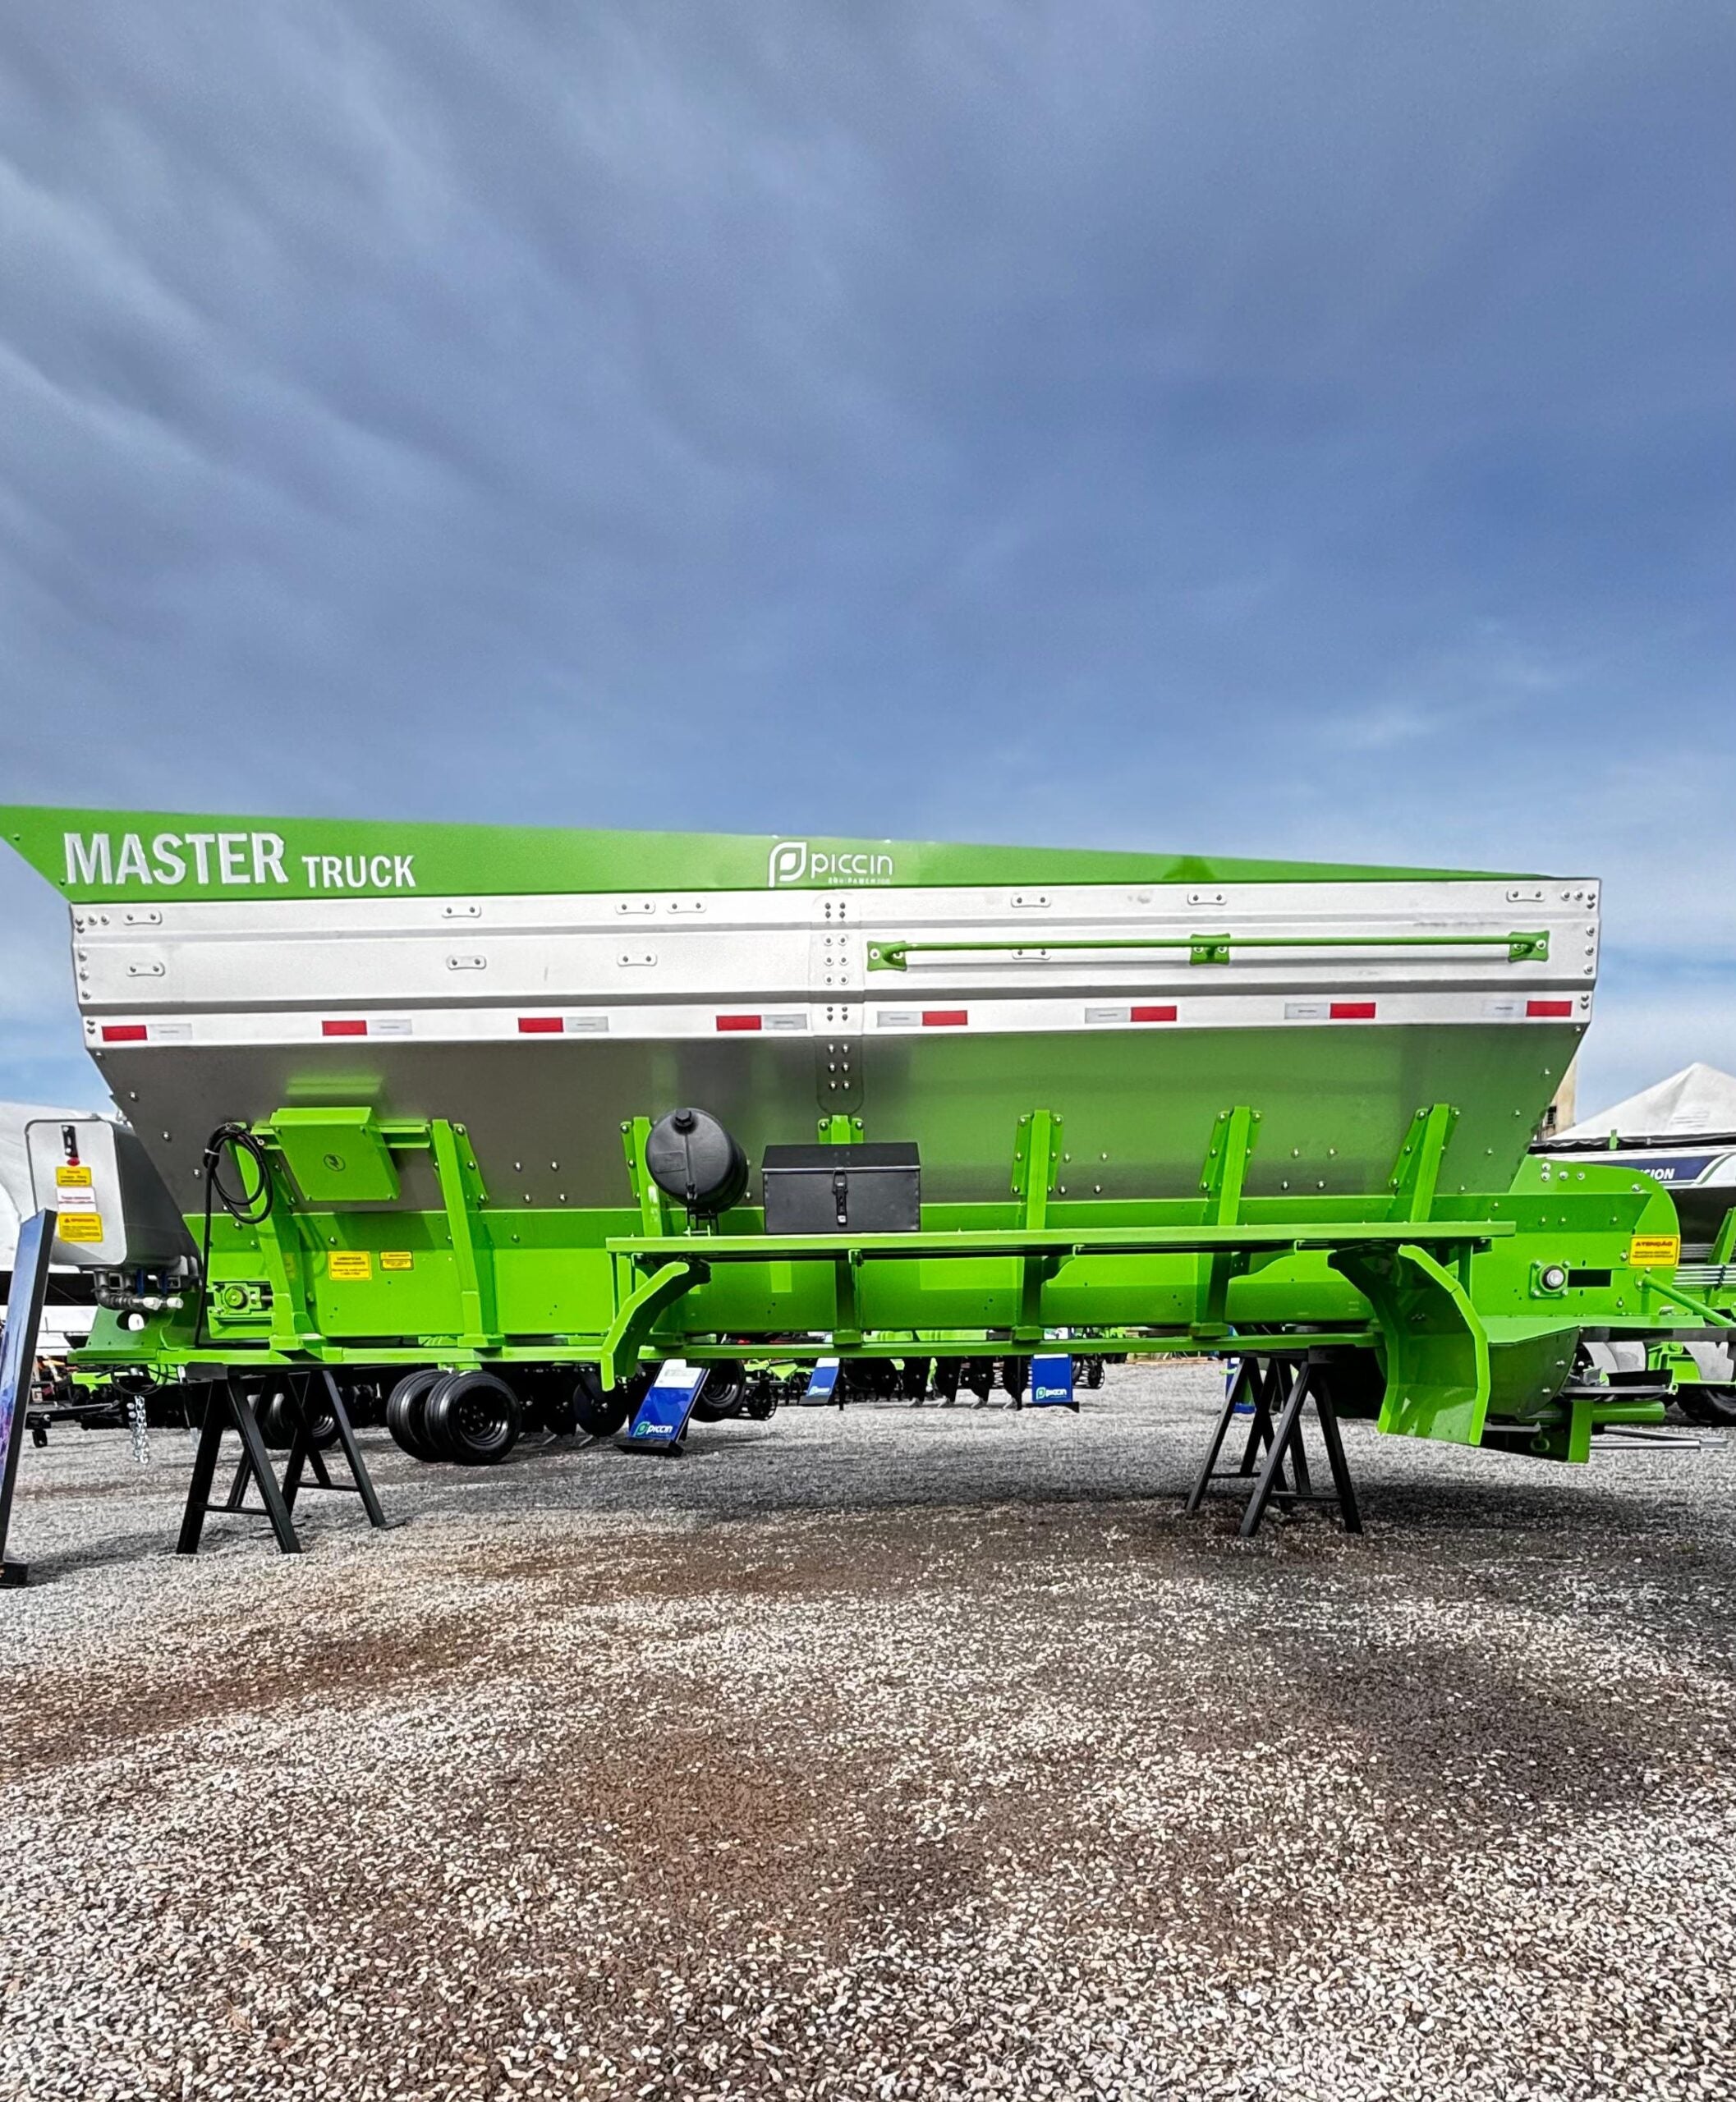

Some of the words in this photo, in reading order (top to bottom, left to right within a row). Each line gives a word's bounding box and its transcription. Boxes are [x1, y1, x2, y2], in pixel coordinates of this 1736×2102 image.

[64, 832, 288, 885] MASTER
[301, 855, 416, 888] TRUCK
[811, 853, 893, 879] piccin
[645, 1425, 673, 1434] piccin
